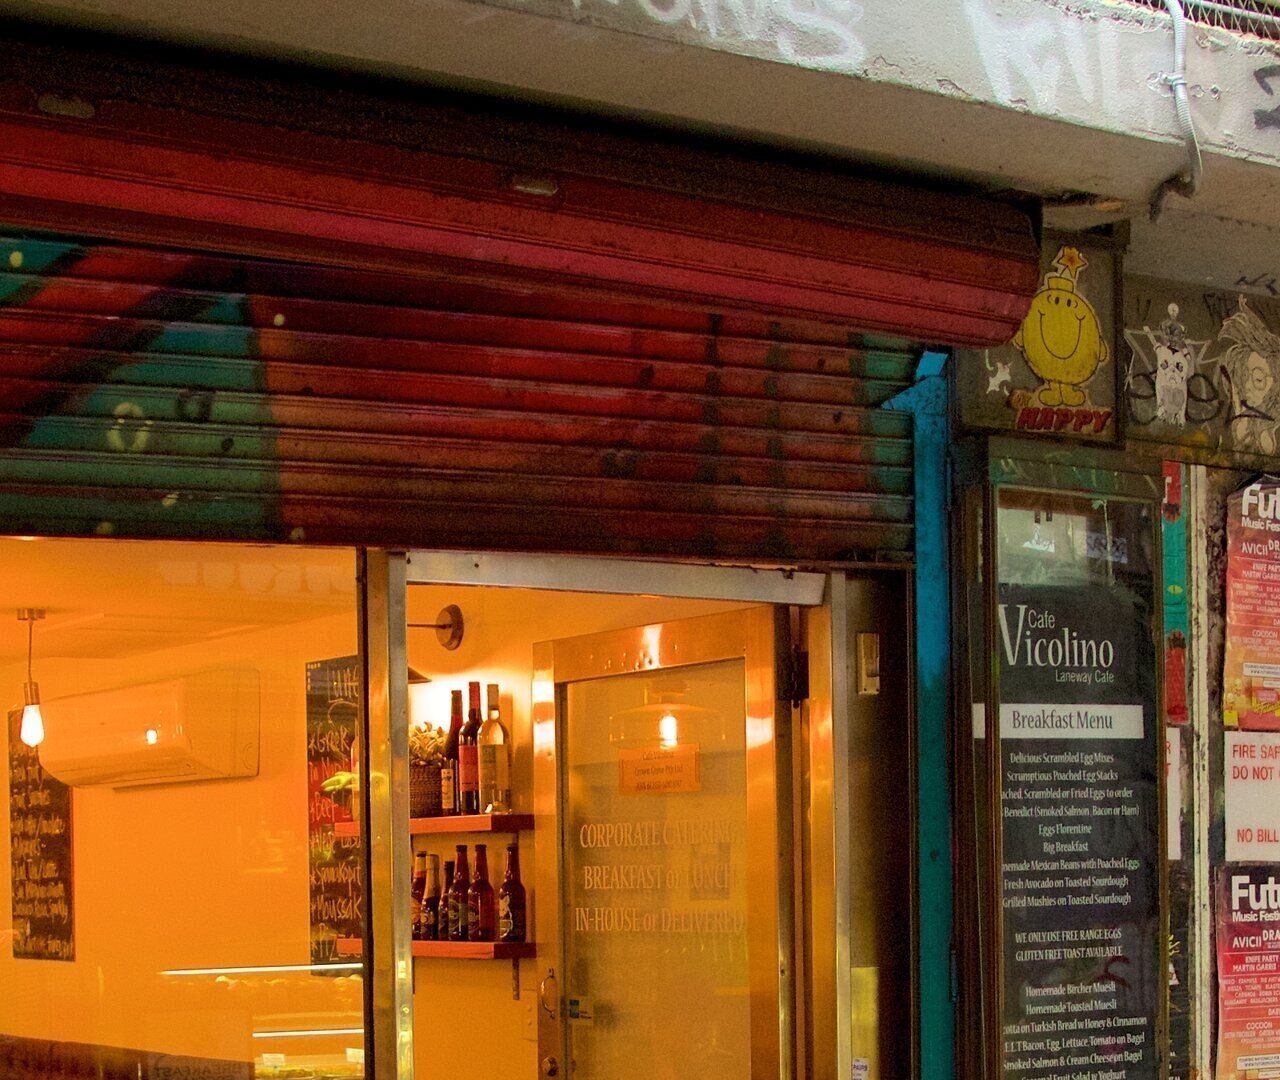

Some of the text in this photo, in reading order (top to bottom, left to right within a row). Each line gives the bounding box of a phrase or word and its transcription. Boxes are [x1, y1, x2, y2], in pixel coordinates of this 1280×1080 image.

[1015, 407, 1112, 435] HAPPY
[1242, 517, 1264, 530] Music
[1242, 543, 1268, 556] AVICII
[1028, 610, 1055, 629] Cafe
[998, 604, 1114, 668] Vicolino
[1056, 669, 1114, 685] Laneway Cafe
[1012, 710, 1112, 729] Breakfast Menu
[1232, 744, 1256, 759] FIRE
[1232, 766, 1248, 780] DO
[1252, 766, 1274, 781] NOT
[580, 823, 661, 848] CORPORATE
[1039, 825, 1092, 837] Eggs Florentine
[1237, 829, 1253, 842] NO
[1257, 829, 1279, 843] BILL
[1043, 841, 1088, 854] Big Breakfast
[584, 864, 663, 889] BREAKFAST
[575, 907, 640, 931] IN-HOUSE
[1232, 911, 1258, 922] Music
[1233, 935, 1261, 948] AVICII
